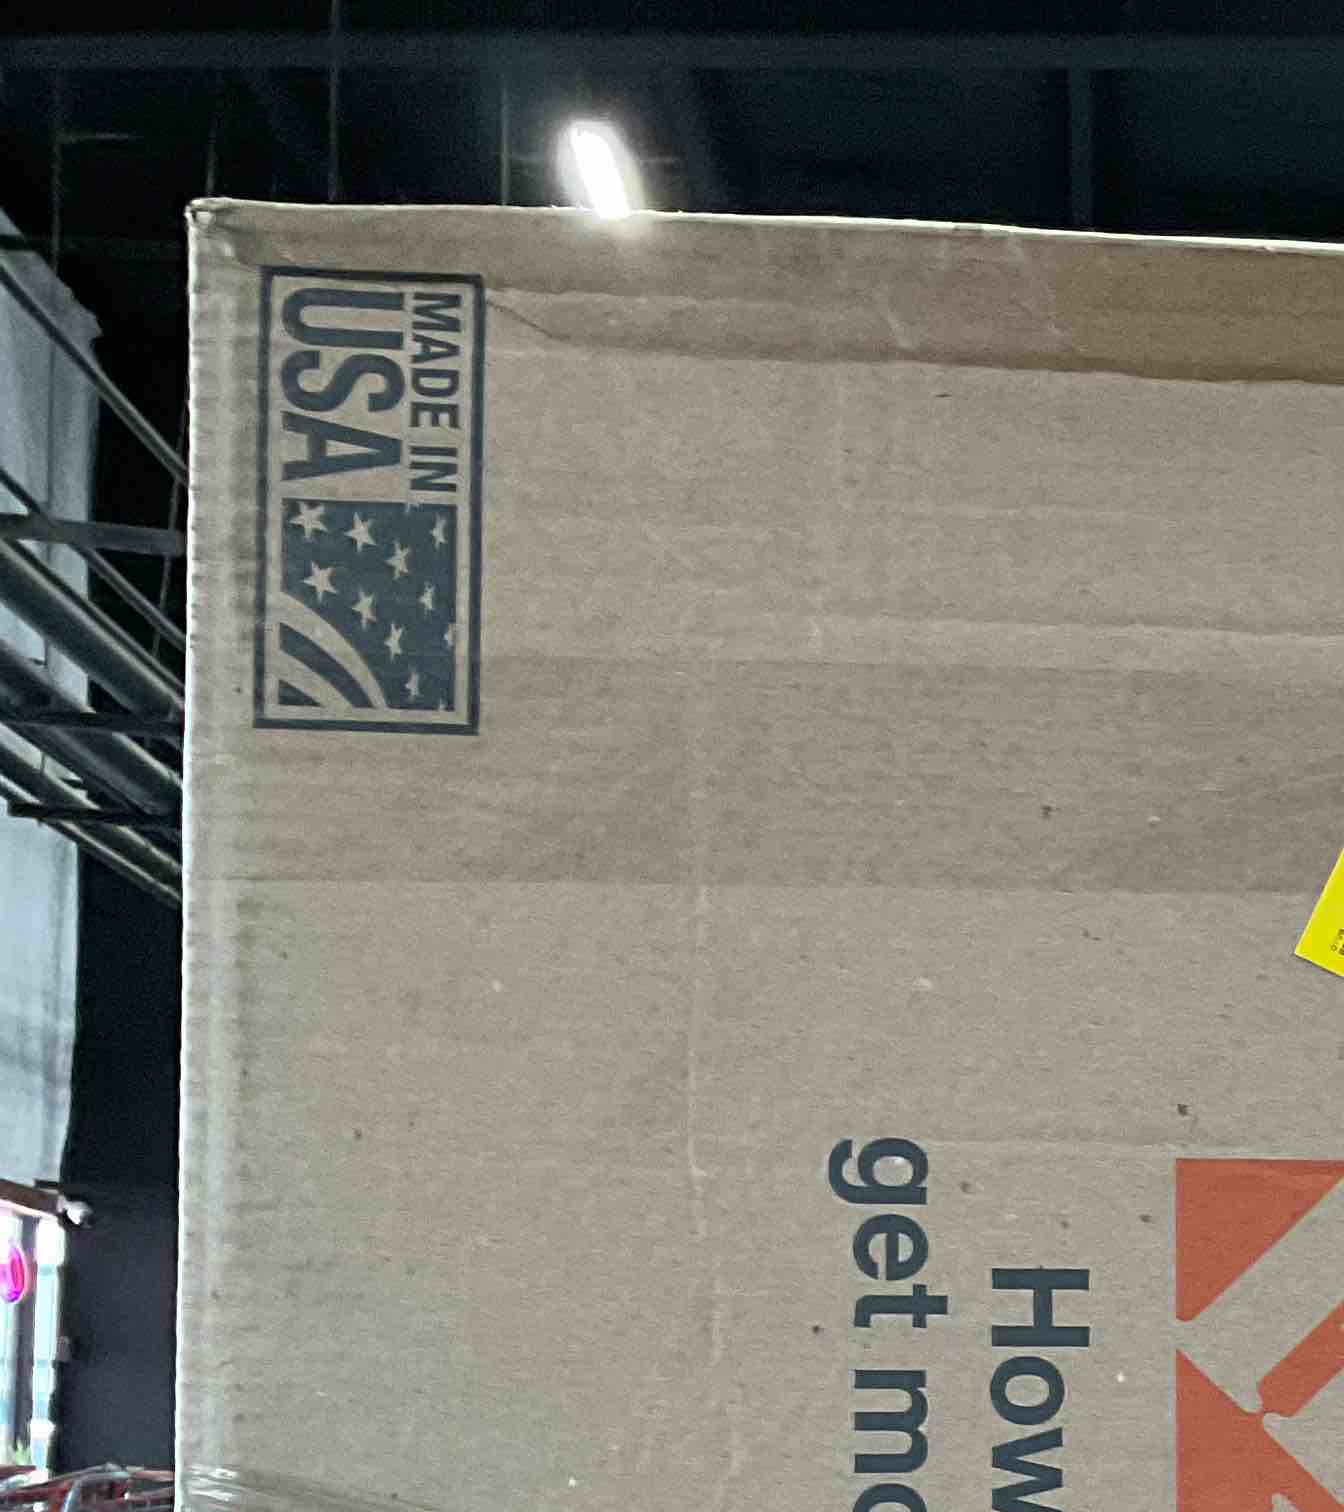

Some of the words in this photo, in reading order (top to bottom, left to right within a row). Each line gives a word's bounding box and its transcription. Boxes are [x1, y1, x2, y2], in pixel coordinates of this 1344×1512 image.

[280, 287, 405, 481] USA
[409, 291, 462, 428] MADE
[408, 445, 459, 493] IN
[827, 1136, 949, 1329] get
